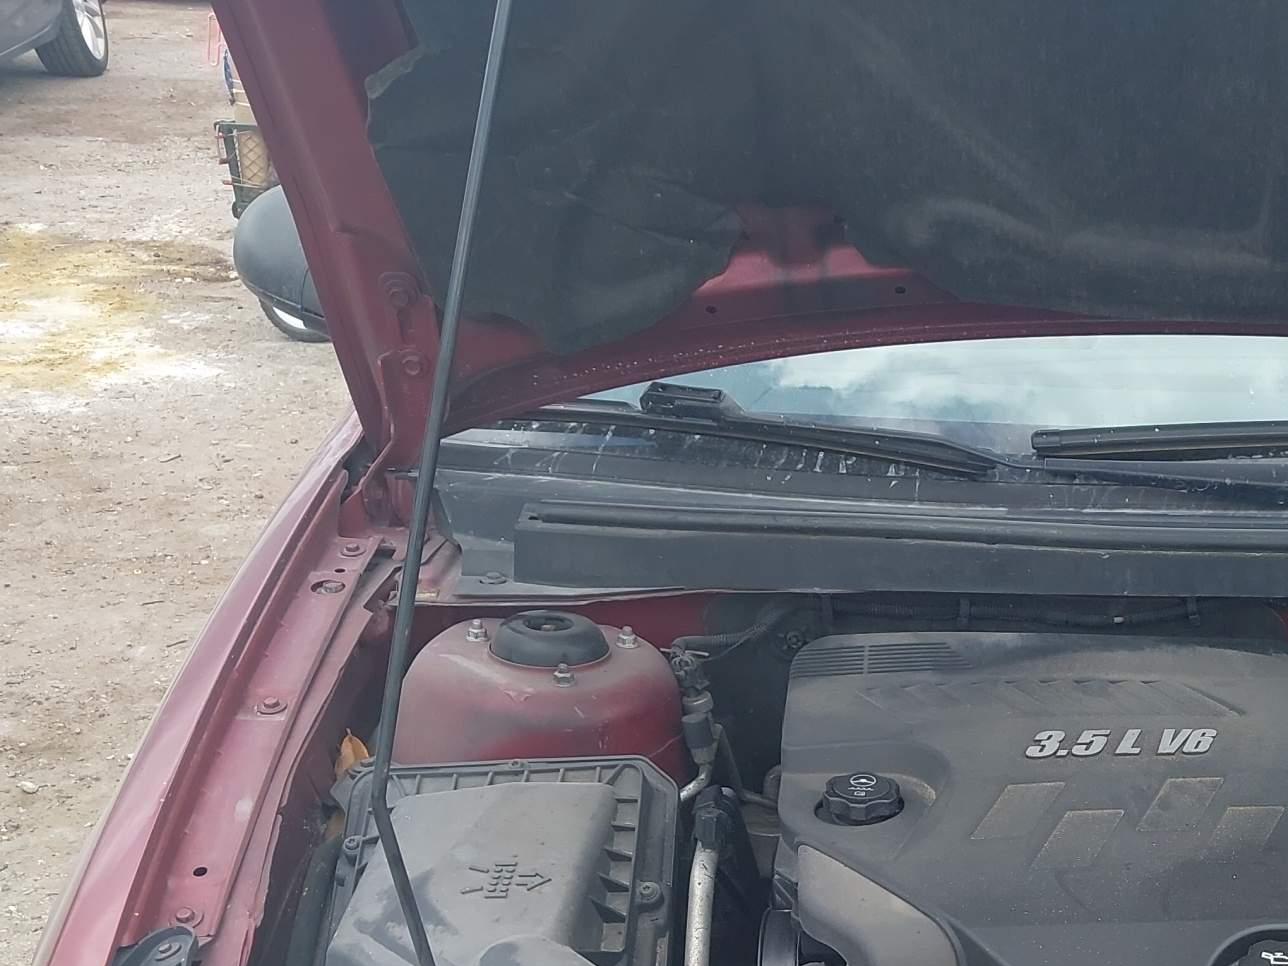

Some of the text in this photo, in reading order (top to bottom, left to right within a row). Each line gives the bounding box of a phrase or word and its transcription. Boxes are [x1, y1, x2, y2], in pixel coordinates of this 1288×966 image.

[1025, 728, 1218, 758] 3.5 L V6
